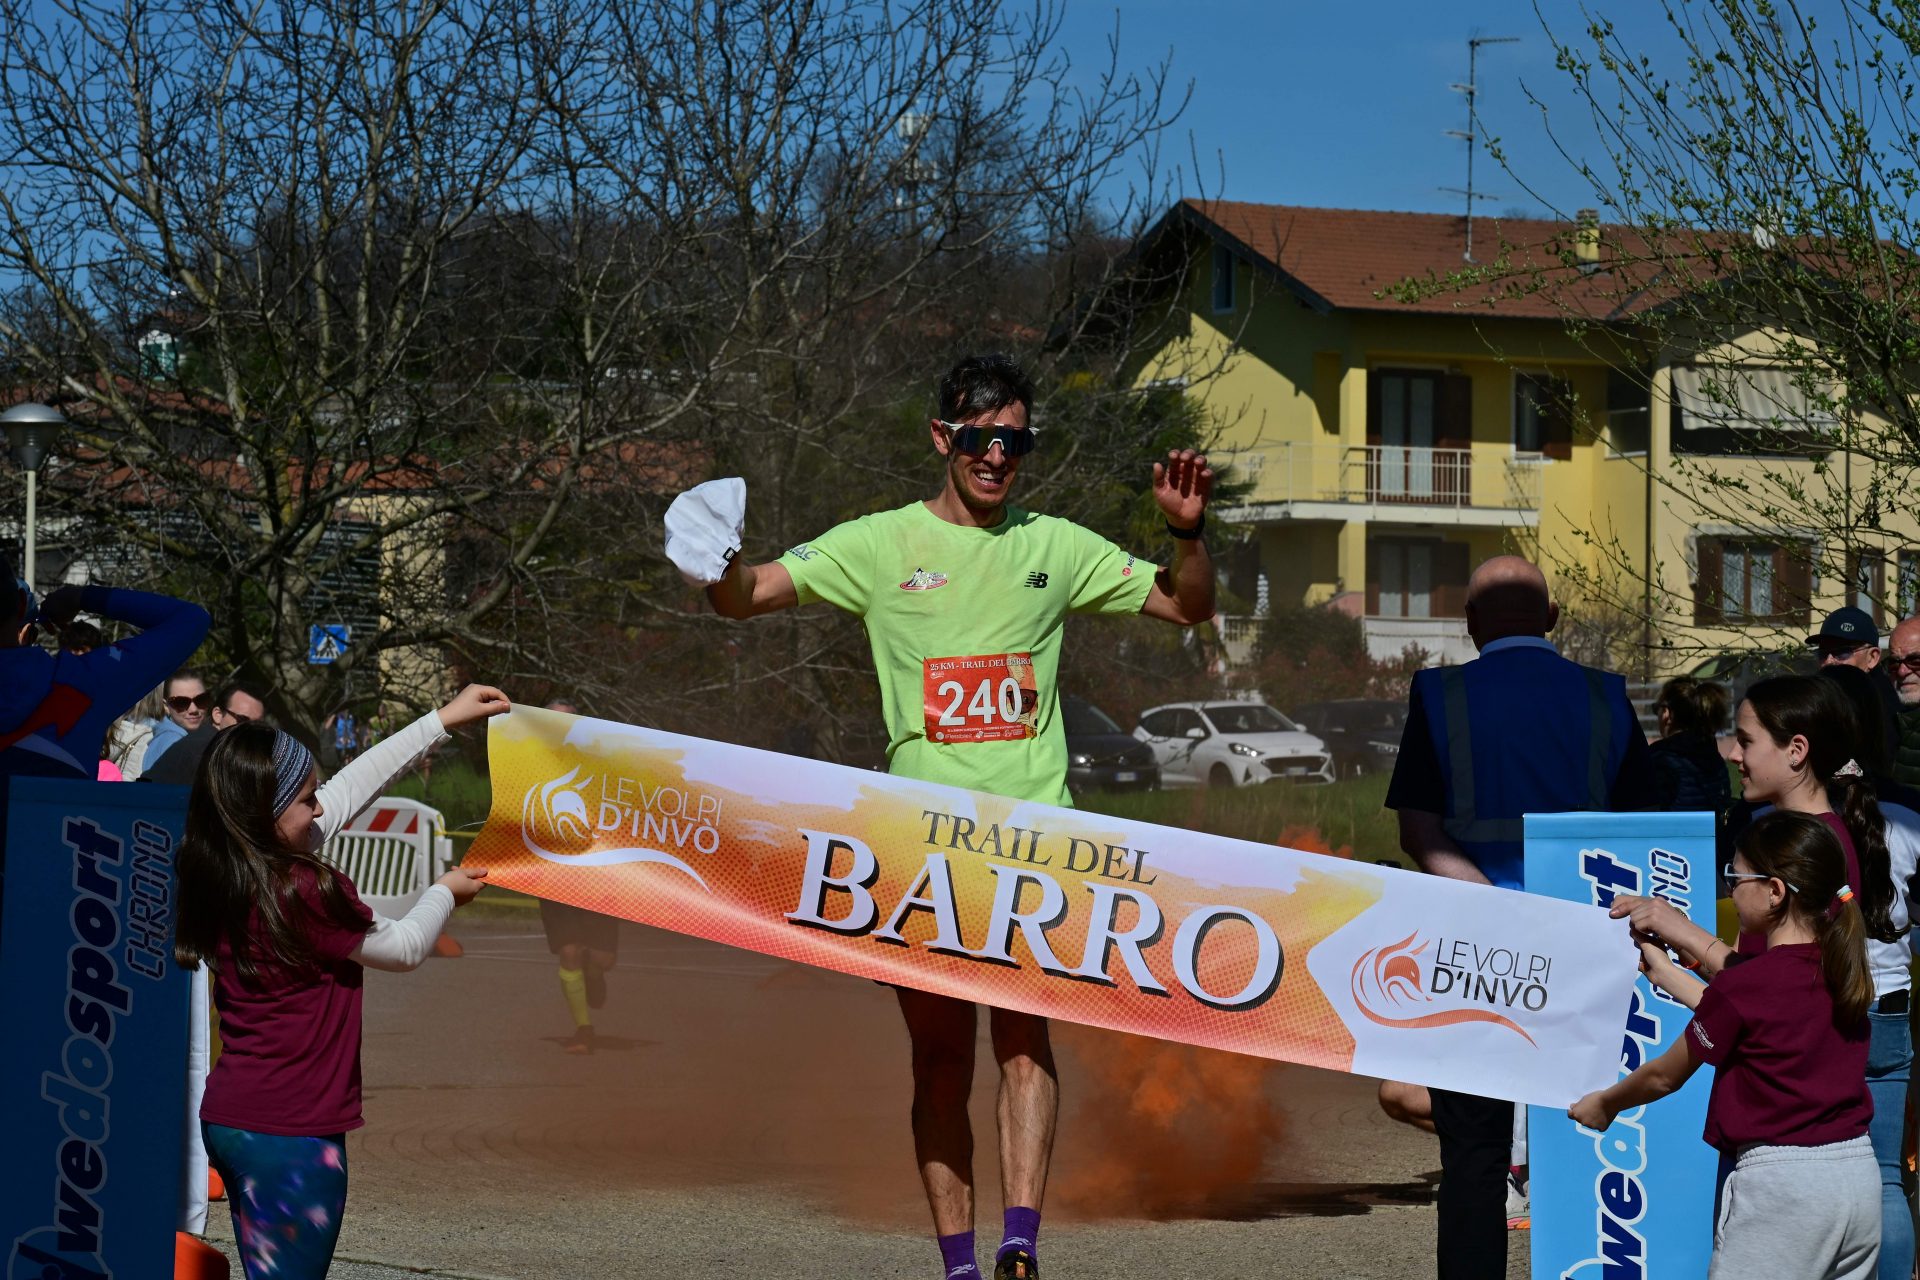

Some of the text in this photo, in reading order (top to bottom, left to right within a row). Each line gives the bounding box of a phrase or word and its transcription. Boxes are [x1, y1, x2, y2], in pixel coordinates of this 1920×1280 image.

[930, 663, 939, 671] 25
[940, 661, 955, 670] KM
[960, 659, 988, 669] TRAIL
[988, 658, 1006, 667] DEL
[937, 677, 1022, 726] 240
[601, 773, 723, 827] LE VOLPI
[921, 809, 1158, 886] TRAIL DEL
[125, 820, 172, 980] CHRONO
[783, 828, 1285, 1012] BARRO
[1436, 937, 1551, 984] LE VOLPI
[42, 815, 132, 1256] wedosport
